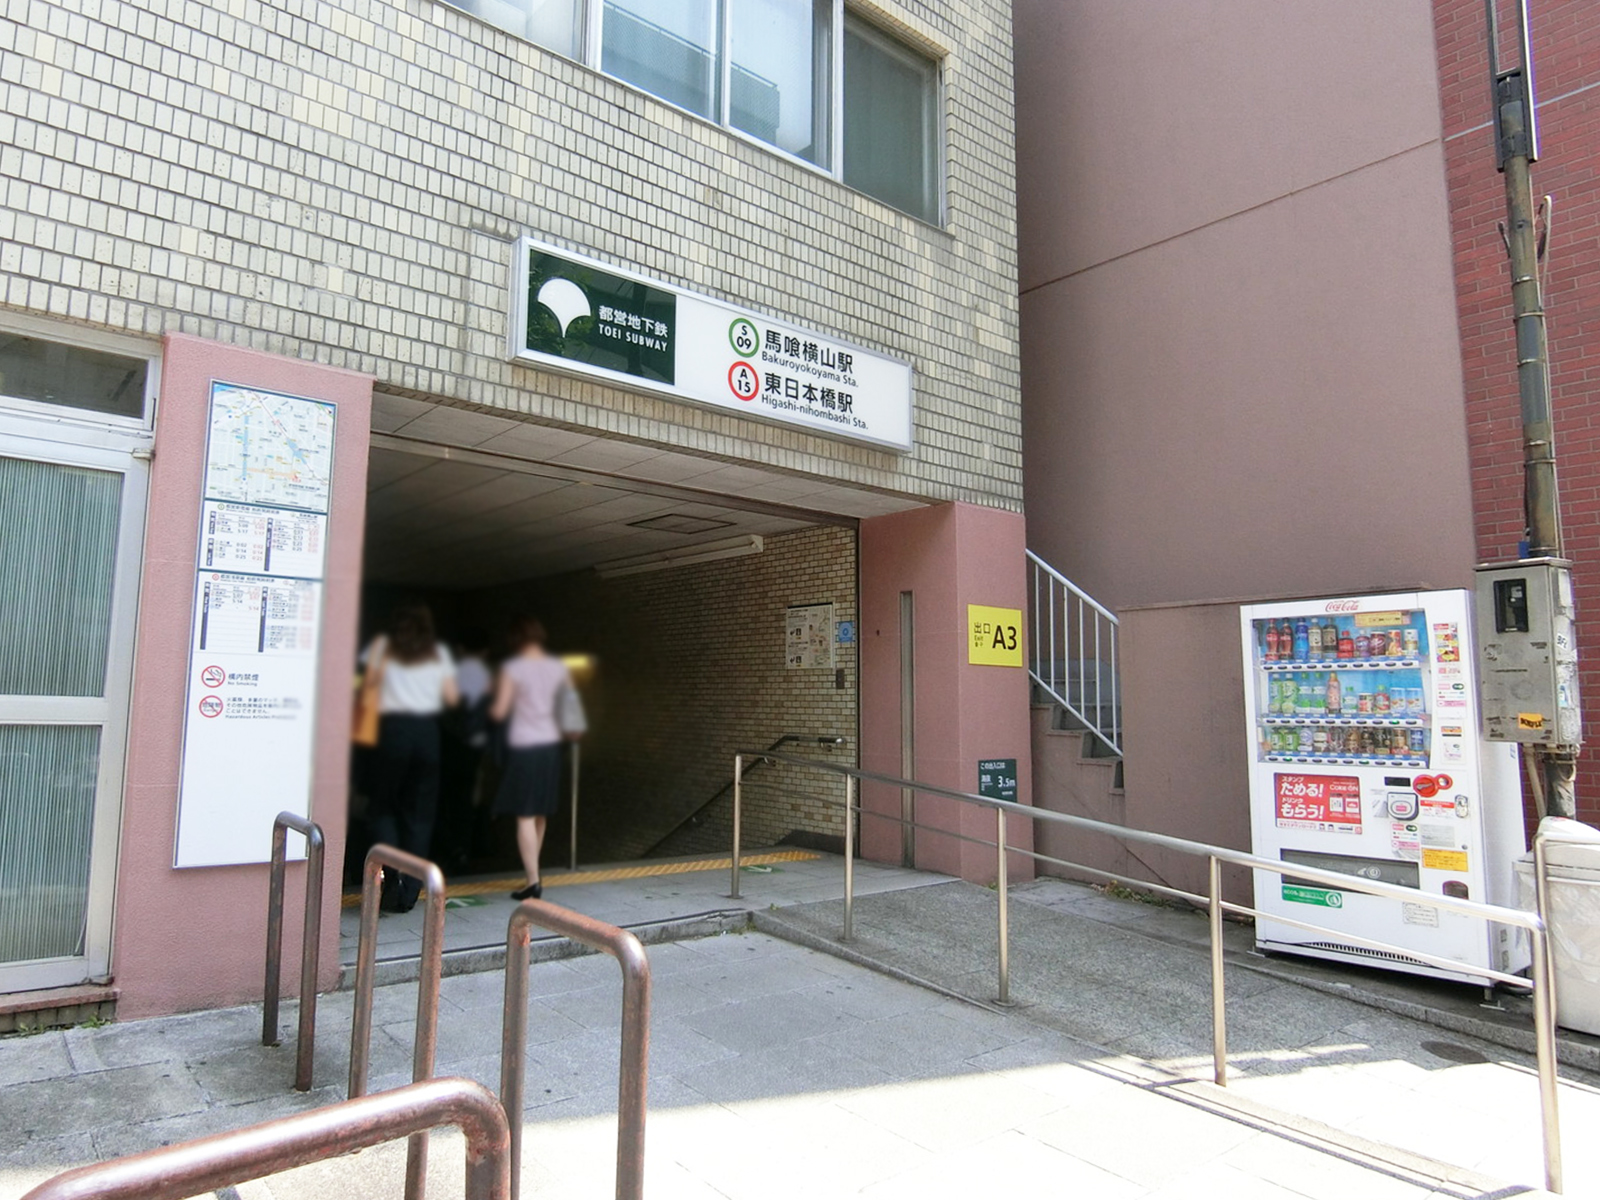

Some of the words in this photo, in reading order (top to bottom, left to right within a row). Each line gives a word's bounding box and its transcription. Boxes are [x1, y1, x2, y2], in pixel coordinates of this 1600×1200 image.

[599, 305, 668, 338] 都営地下鉄
[599, 323, 622, 339] TOEI
[626, 331, 667, 352] SUBWAY
[741, 325, 748, 336] S
[736, 335, 752, 350] 09
[765, 329, 853, 374] 馬喰横山駅
[740, 368, 748, 379] A
[762, 351, 841, 382] Bakuroyokoyama
[842, 374, 859, 388] Sta.
[737, 379, 751, 393] 15
[765, 372, 853, 414] 東日本橋駅
[762, 393, 851, 425] Higashi-nihombashi
[853, 417, 869, 430] Sta.
[974, 621, 990, 634] 出口
[992, 625, 1017, 650] A3
[998, 775, 1015, 788] 3.5m
[1280, 782, 1324, 797] ためる!
[1281, 803, 1324, 819] もらう!
